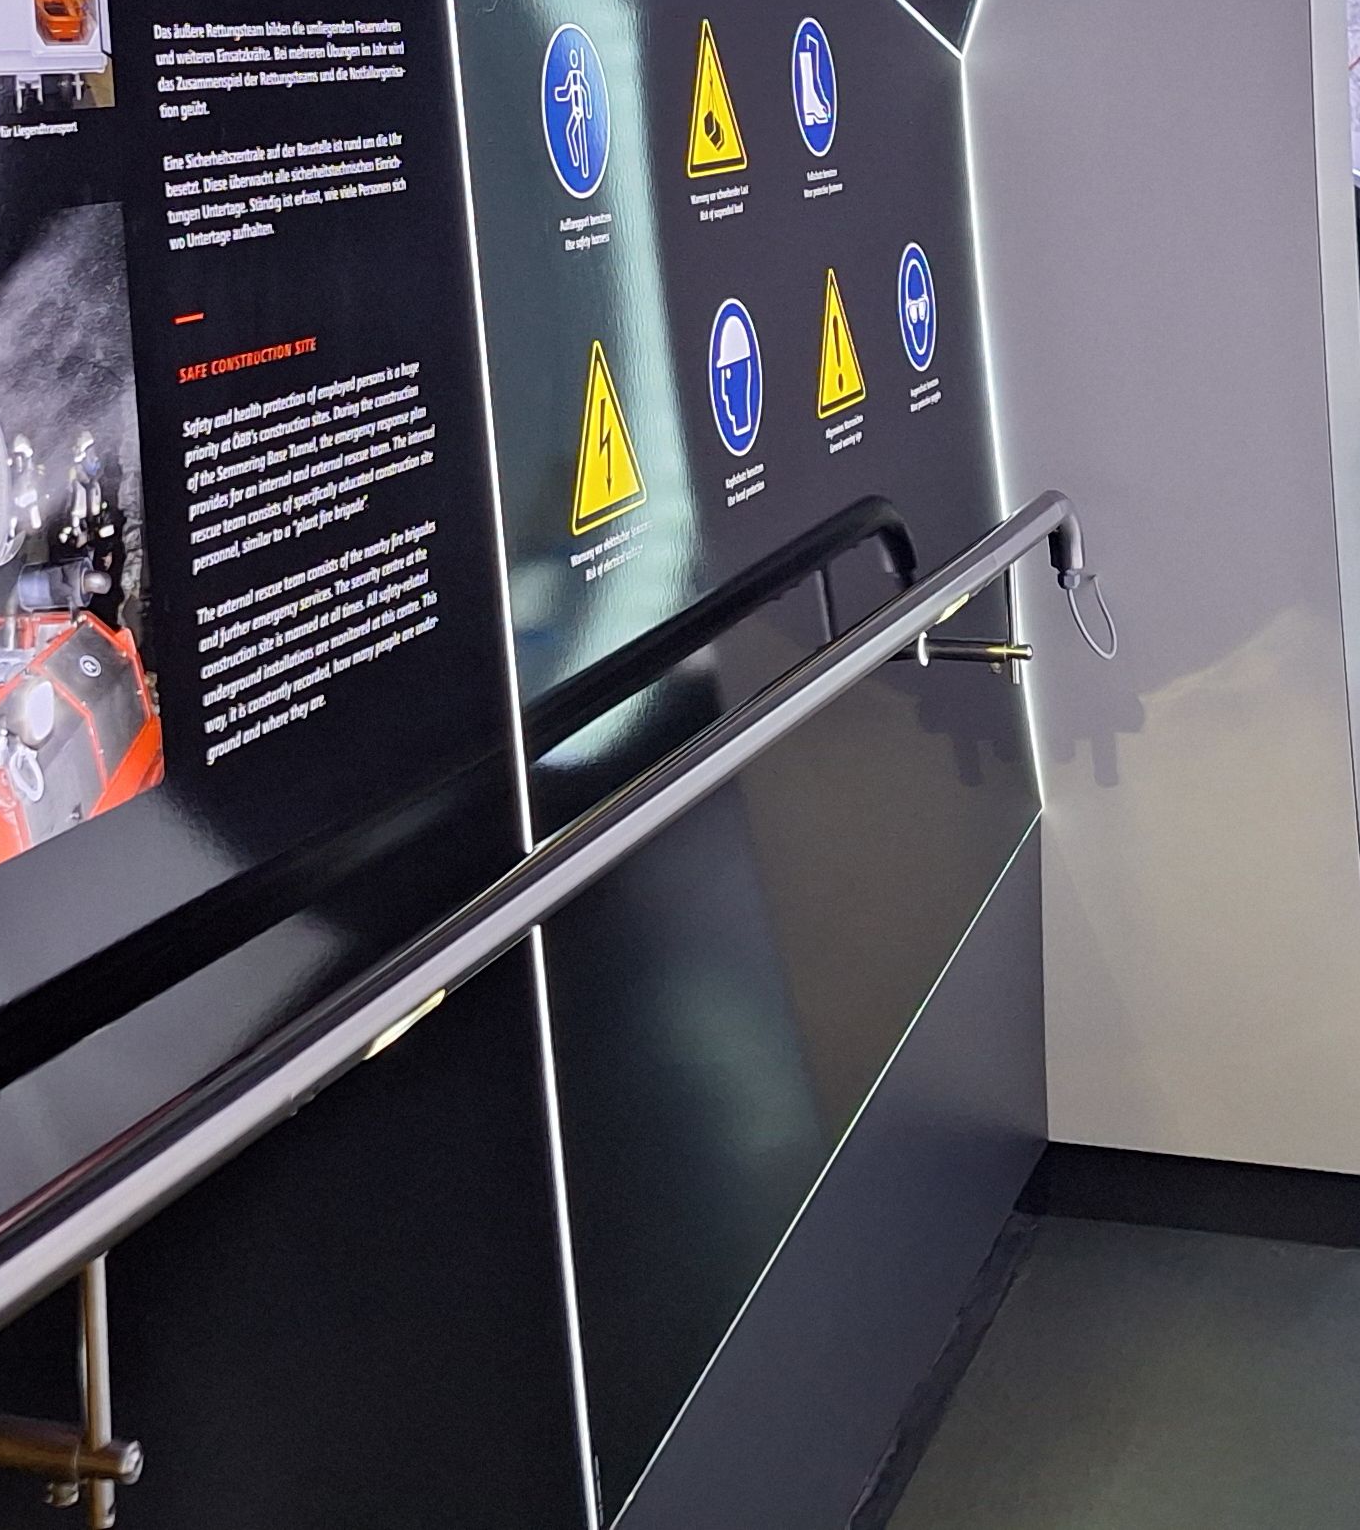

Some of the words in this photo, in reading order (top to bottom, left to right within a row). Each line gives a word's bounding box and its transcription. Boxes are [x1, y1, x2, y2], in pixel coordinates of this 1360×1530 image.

[0, 125, 13, 138] für
[179, 362, 208, 384] SAFE
[210, 343, 293, 375] CONSTRUCTION
[294, 337, 316, 356] SITE
[196, 606, 216, 625] The
[216, 588, 254, 618] external
[254, 580, 283, 603] rescue
[283, 571, 306, 591] team
[306, 558, 339, 582] consists
[339, 550, 350, 571] of
[349, 548, 364, 565] the
[363, 538, 391, 559] nearby
[390, 532, 405, 553] fire
[402, 520, 436, 543] brigades
[198, 629, 219, 653] and
[218, 620, 252, 649] further
[251, 601, 299, 631] emergency
[299, 582, 336, 612] services.
[333, 578, 351, 596] The
[350, 566, 381, 590] security
[381, 557, 405, 577] centre
[405, 552, 415, 567] at
[414, 547, 428, 563] the
[200, 645, 258, 680] construction
[257, 637, 275, 656] site
[274, 631, 284, 648] is
[284, 614, 319, 644] manned
[319, 612, 330, 629] at
[329, 605, 342, 624] all
[341, 599, 366, 619] times.
[365, 589, 378, 608] All
[202, 666, 263, 707] underground
[262, 647, 315, 680] installations
[314, 639, 330, 656] are
[330, 617, 371, 650] monitored
[371, 616, 381, 631] at
[380, 608, 396, 627] this
[396, 600, 422, 620] centre.
[421, 590, 438, 608] This
[204, 713, 228, 734] way,
[229, 706, 238, 723] it
[237, 702, 247, 719] is
[247, 681, 293, 715] constantly
[290, 662, 332, 693] recorded,
[332, 655, 352, 674] how
[352, 645, 375, 665] many
[374, 631, 401, 658] people
[401, 626, 415, 642] are
[206, 730, 242, 766] ground
[242, 720, 261, 744] and
[261, 711, 290, 735] where
[287, 701, 310, 721] they
[307, 694, 327, 712] are.
